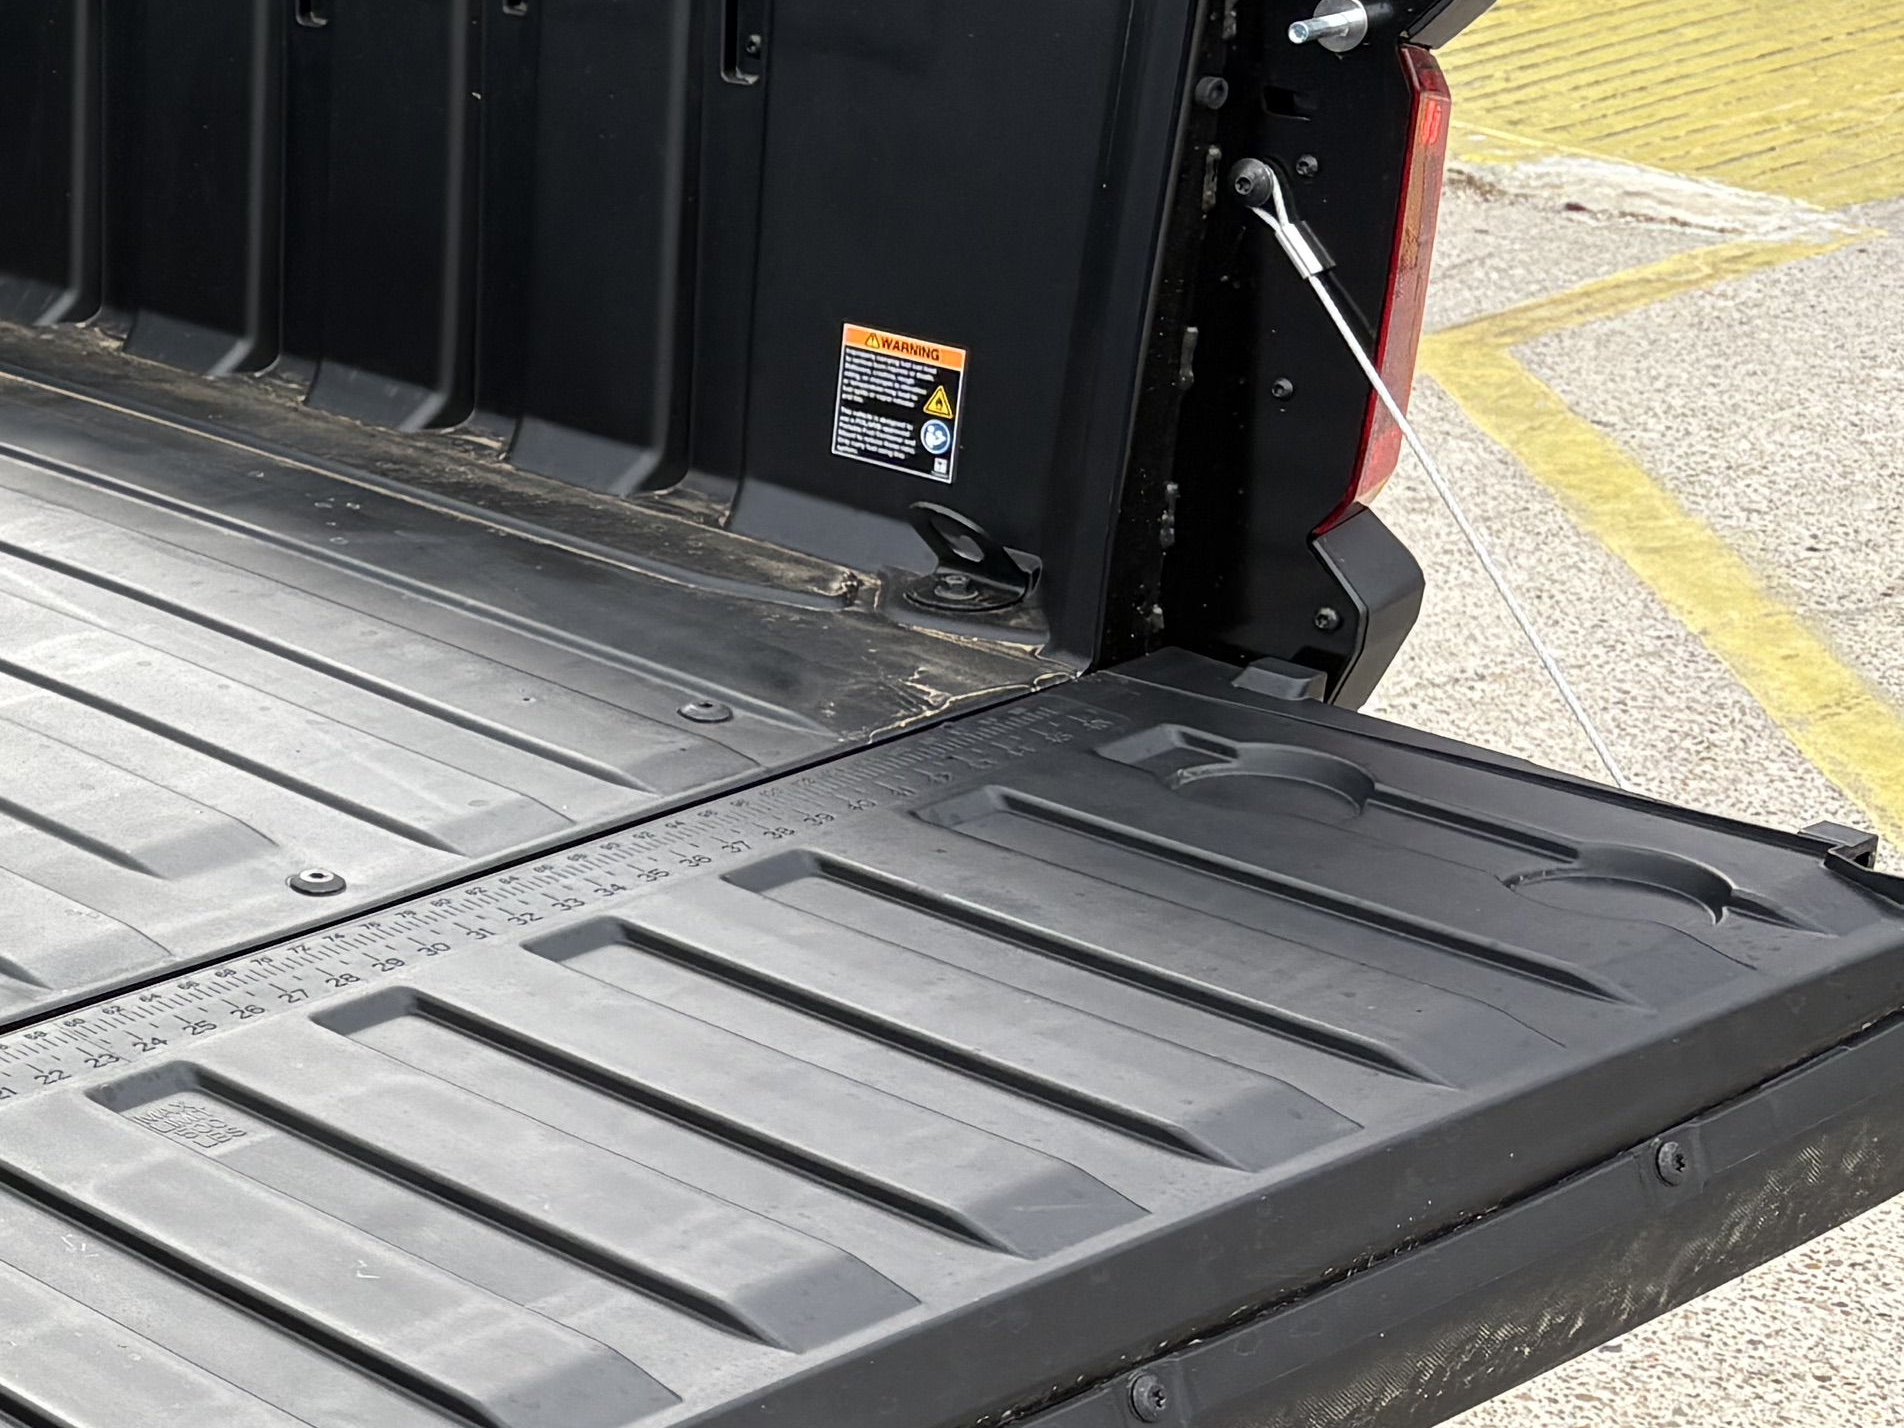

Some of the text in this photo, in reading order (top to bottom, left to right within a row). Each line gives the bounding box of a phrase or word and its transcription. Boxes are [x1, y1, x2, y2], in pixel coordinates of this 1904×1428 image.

[880, 337, 941, 361] WARNING
[35, 1070, 70, 1084] 22
[85, 1054, 119, 1067] 23
[134, 1038, 167, 1051] 24
[183, 1021, 216, 1034] 25
[231, 1006, 265, 1018] 26
[279, 990, 309, 1003] 27
[326, 974, 360, 987] 28
[373, 958, 405, 972] 29
[419, 943, 450, 955] 30
[467, 928, 495, 939] 31
[508, 913, 542, 925] 32
[552, 898, 584, 911] 33
[594, 884, 626, 896] 34
[637, 869, 669, 882] 35
[679, 855, 711, 867] 36
[722, 841, 751, 853] 37
